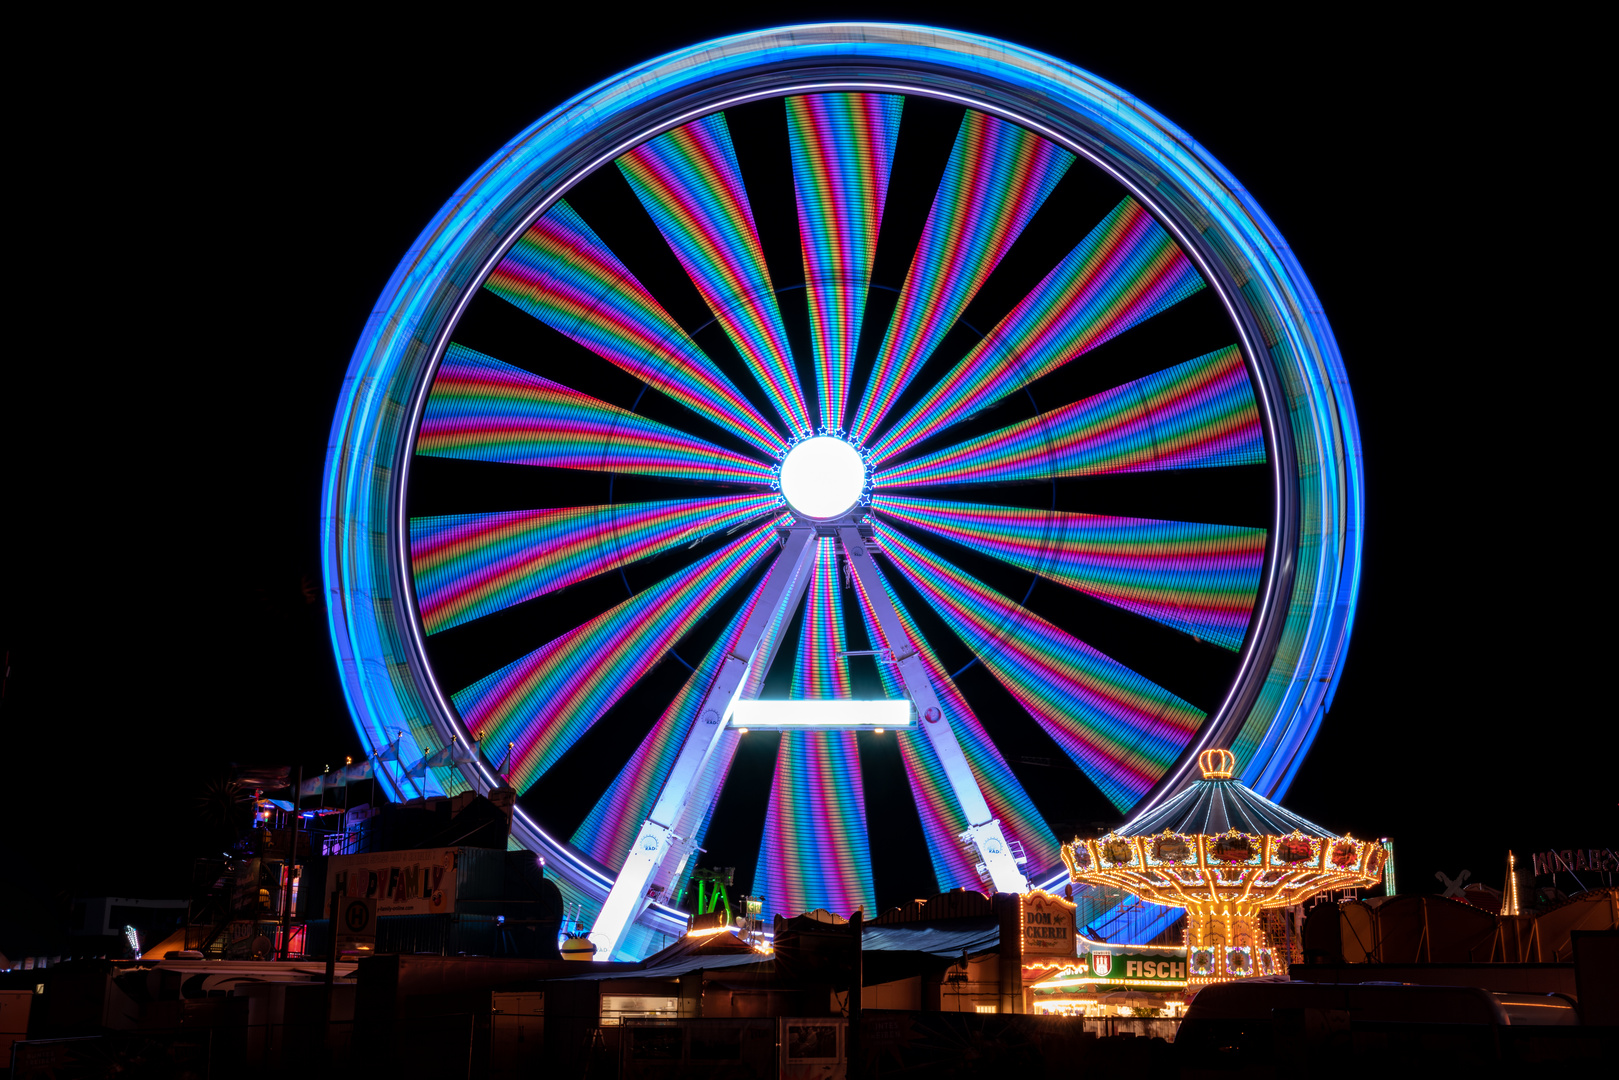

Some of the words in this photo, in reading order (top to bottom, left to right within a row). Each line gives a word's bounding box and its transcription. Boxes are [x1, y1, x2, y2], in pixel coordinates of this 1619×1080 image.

[351, 908, 364, 925] H
[1027, 912, 1052, 925] DOM
[1024, 926, 1067, 939] CKEREI
[1126, 960, 1185, 979] FISCH
